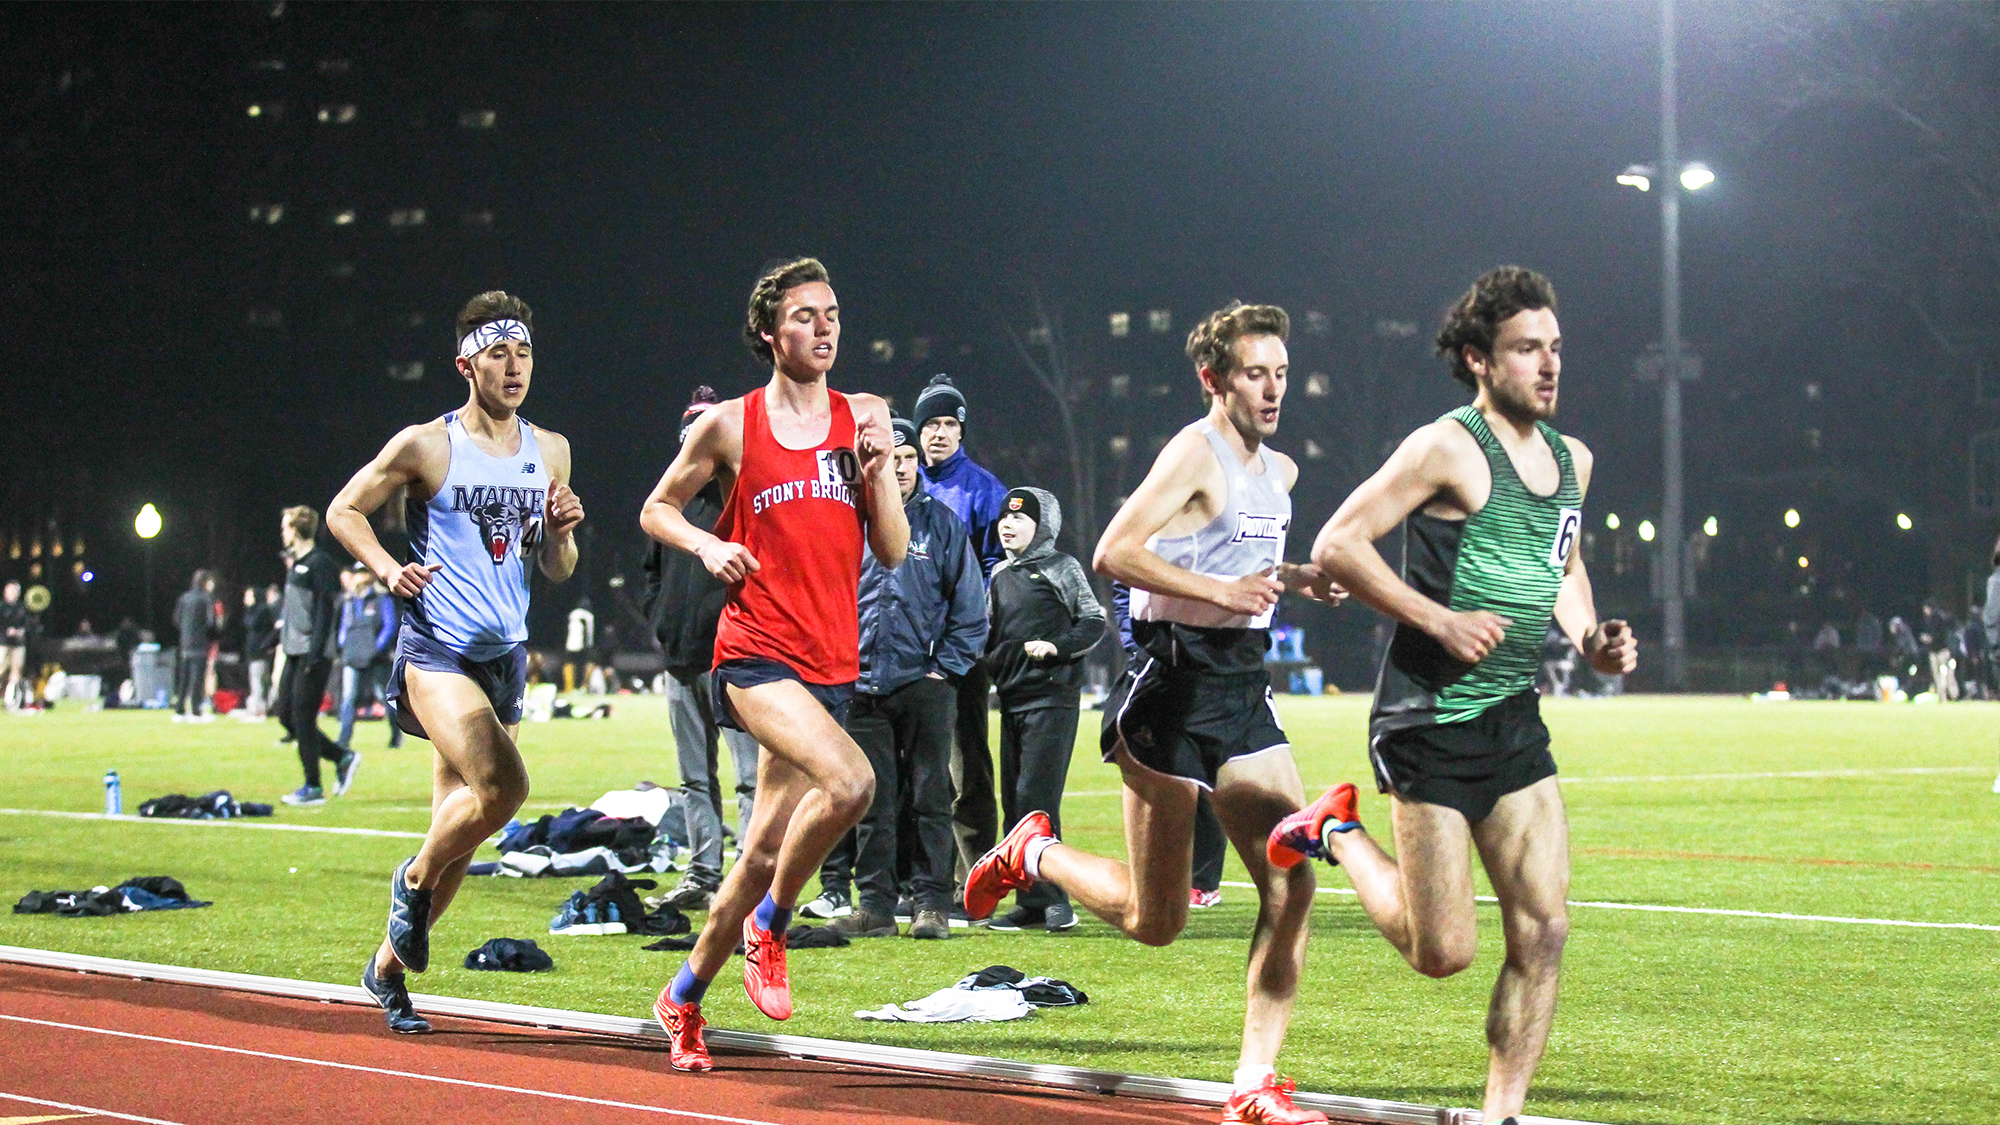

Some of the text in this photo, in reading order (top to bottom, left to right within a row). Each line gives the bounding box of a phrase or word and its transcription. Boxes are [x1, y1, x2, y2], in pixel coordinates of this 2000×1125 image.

[820, 450, 858, 482] 10
[450, 485, 545, 514] MAINE
[752, 479, 806, 515] STONY
[521, 520, 540, 555] 4
[1558, 515, 1577, 562] 6
